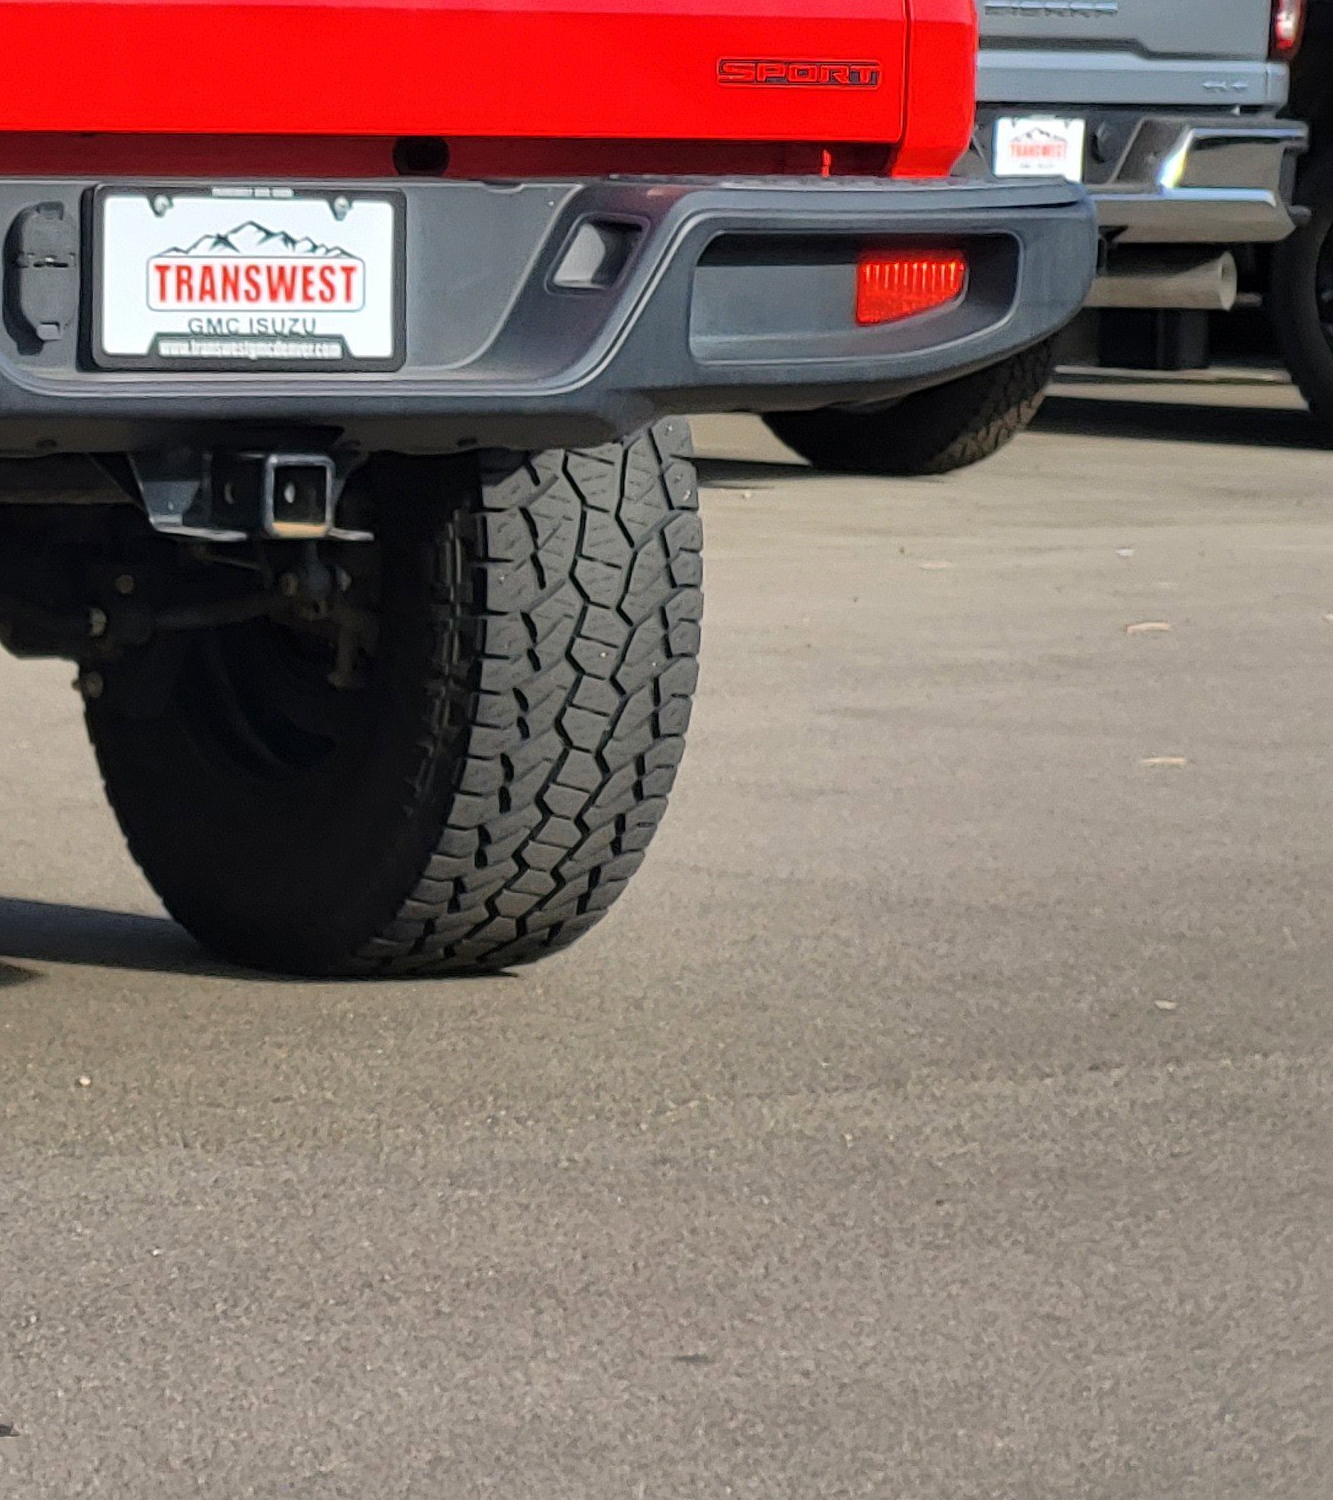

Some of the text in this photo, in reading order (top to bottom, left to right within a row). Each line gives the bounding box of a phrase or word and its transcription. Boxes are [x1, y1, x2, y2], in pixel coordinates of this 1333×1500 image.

[718, 59, 881, 86] SPORT
[154, 264, 358, 303] TRANSWEST
[188, 317, 316, 336] GMC ISUZU
